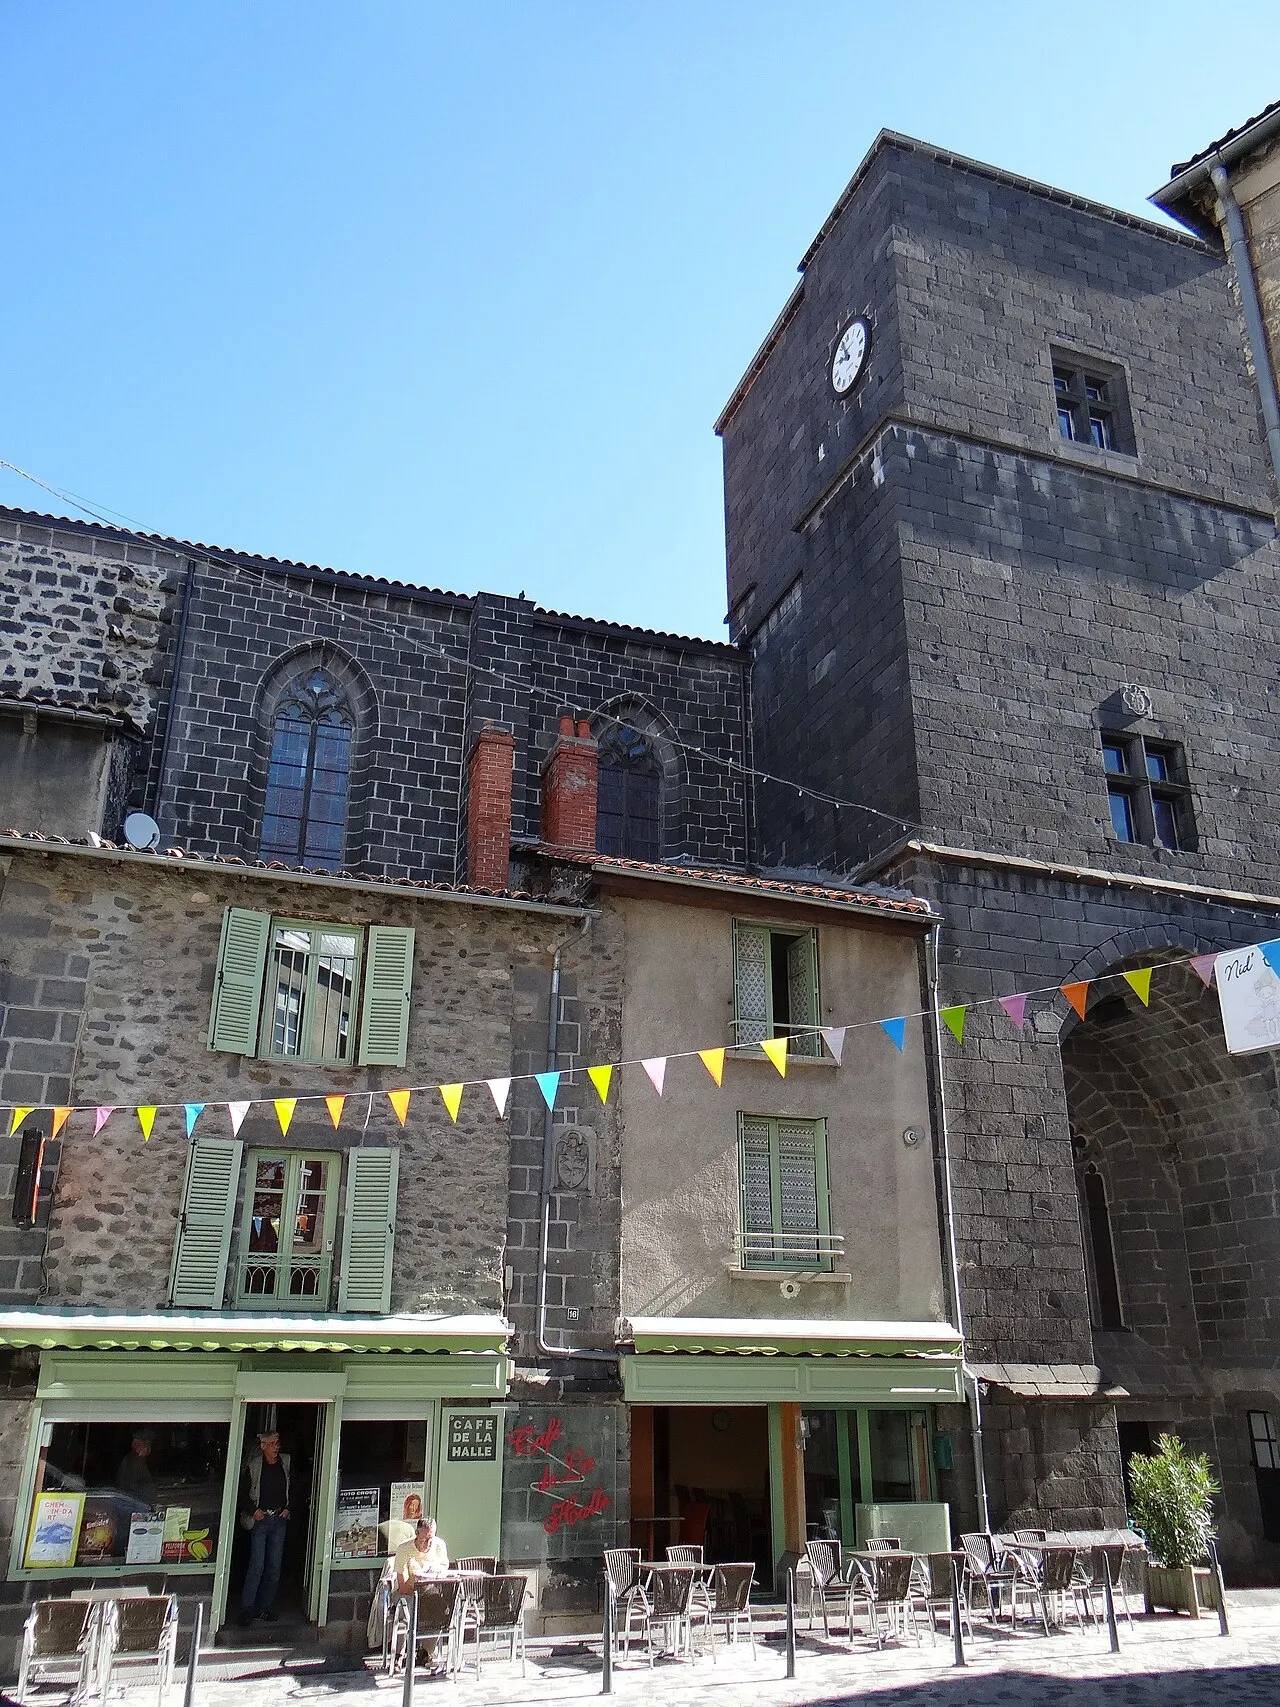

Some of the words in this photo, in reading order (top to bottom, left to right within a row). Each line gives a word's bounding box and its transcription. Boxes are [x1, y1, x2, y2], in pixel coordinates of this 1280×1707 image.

[1224, 952, 1254, 981] Nid'
[453, 1419, 493, 1430] CAFE
[453, 1432, 470, 1442] DE
[475, 1432, 492, 1442] LA
[451, 1446, 492, 1457] HALLE
